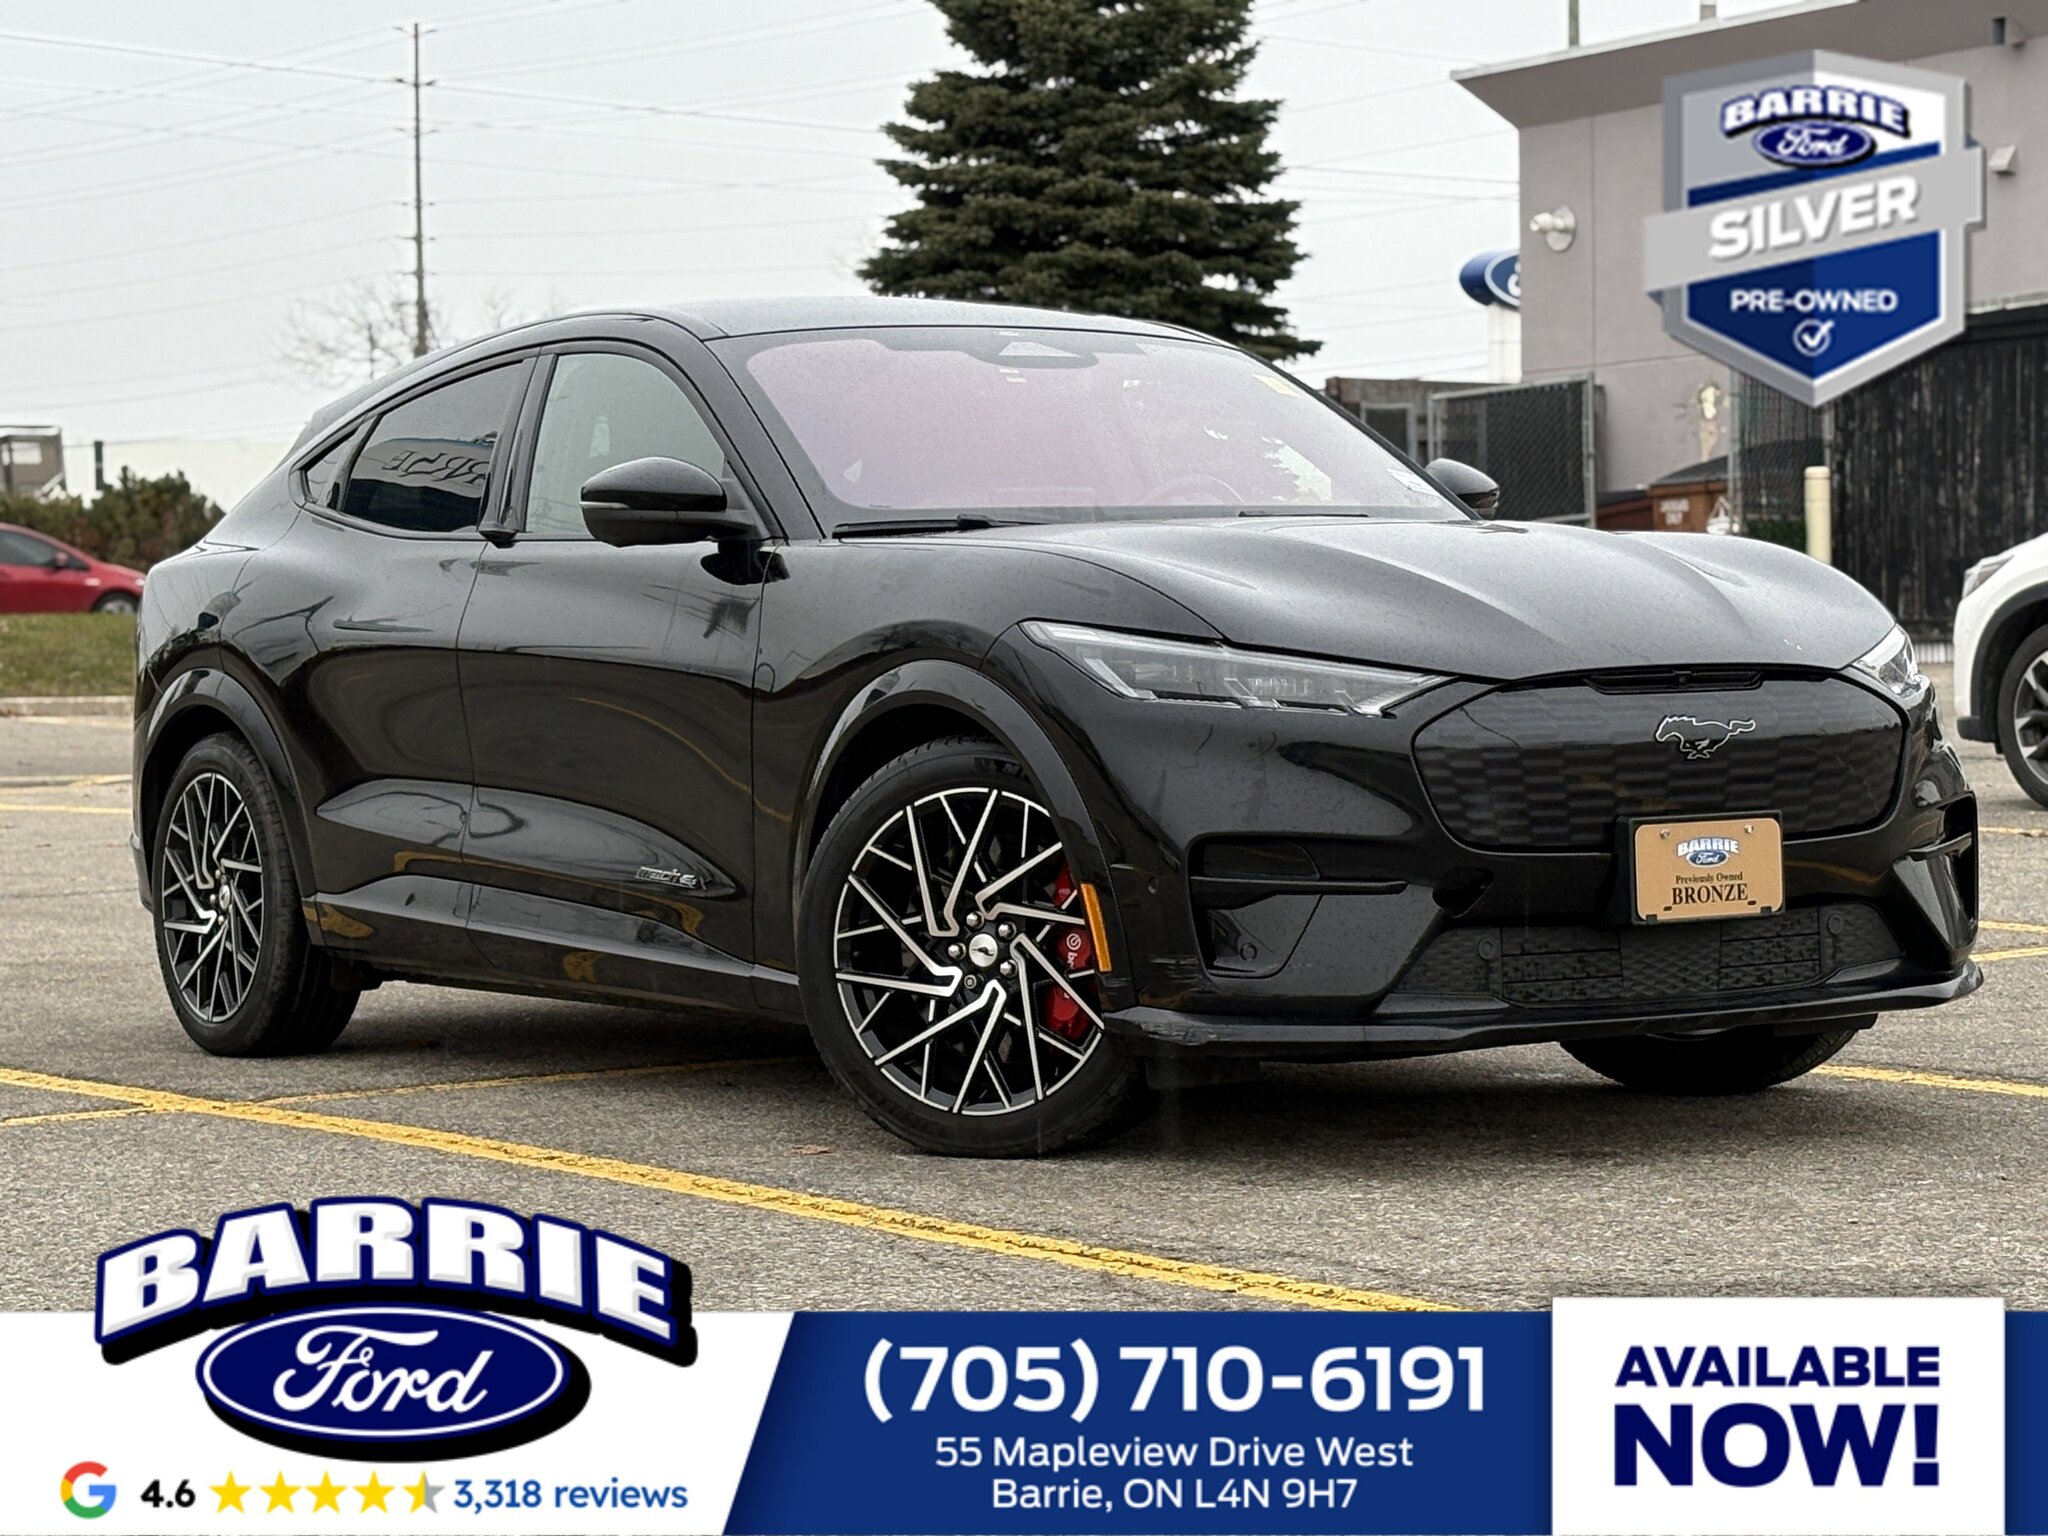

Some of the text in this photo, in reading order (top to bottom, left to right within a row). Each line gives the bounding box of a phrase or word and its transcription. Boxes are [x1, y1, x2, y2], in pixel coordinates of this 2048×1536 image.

[1676, 838, 1739, 857] BARRIE
[1695, 852, 1722, 864] Ford
[1675, 871, 1743, 885] Previously Owned
[1671, 882, 1749, 906] BRONZE
